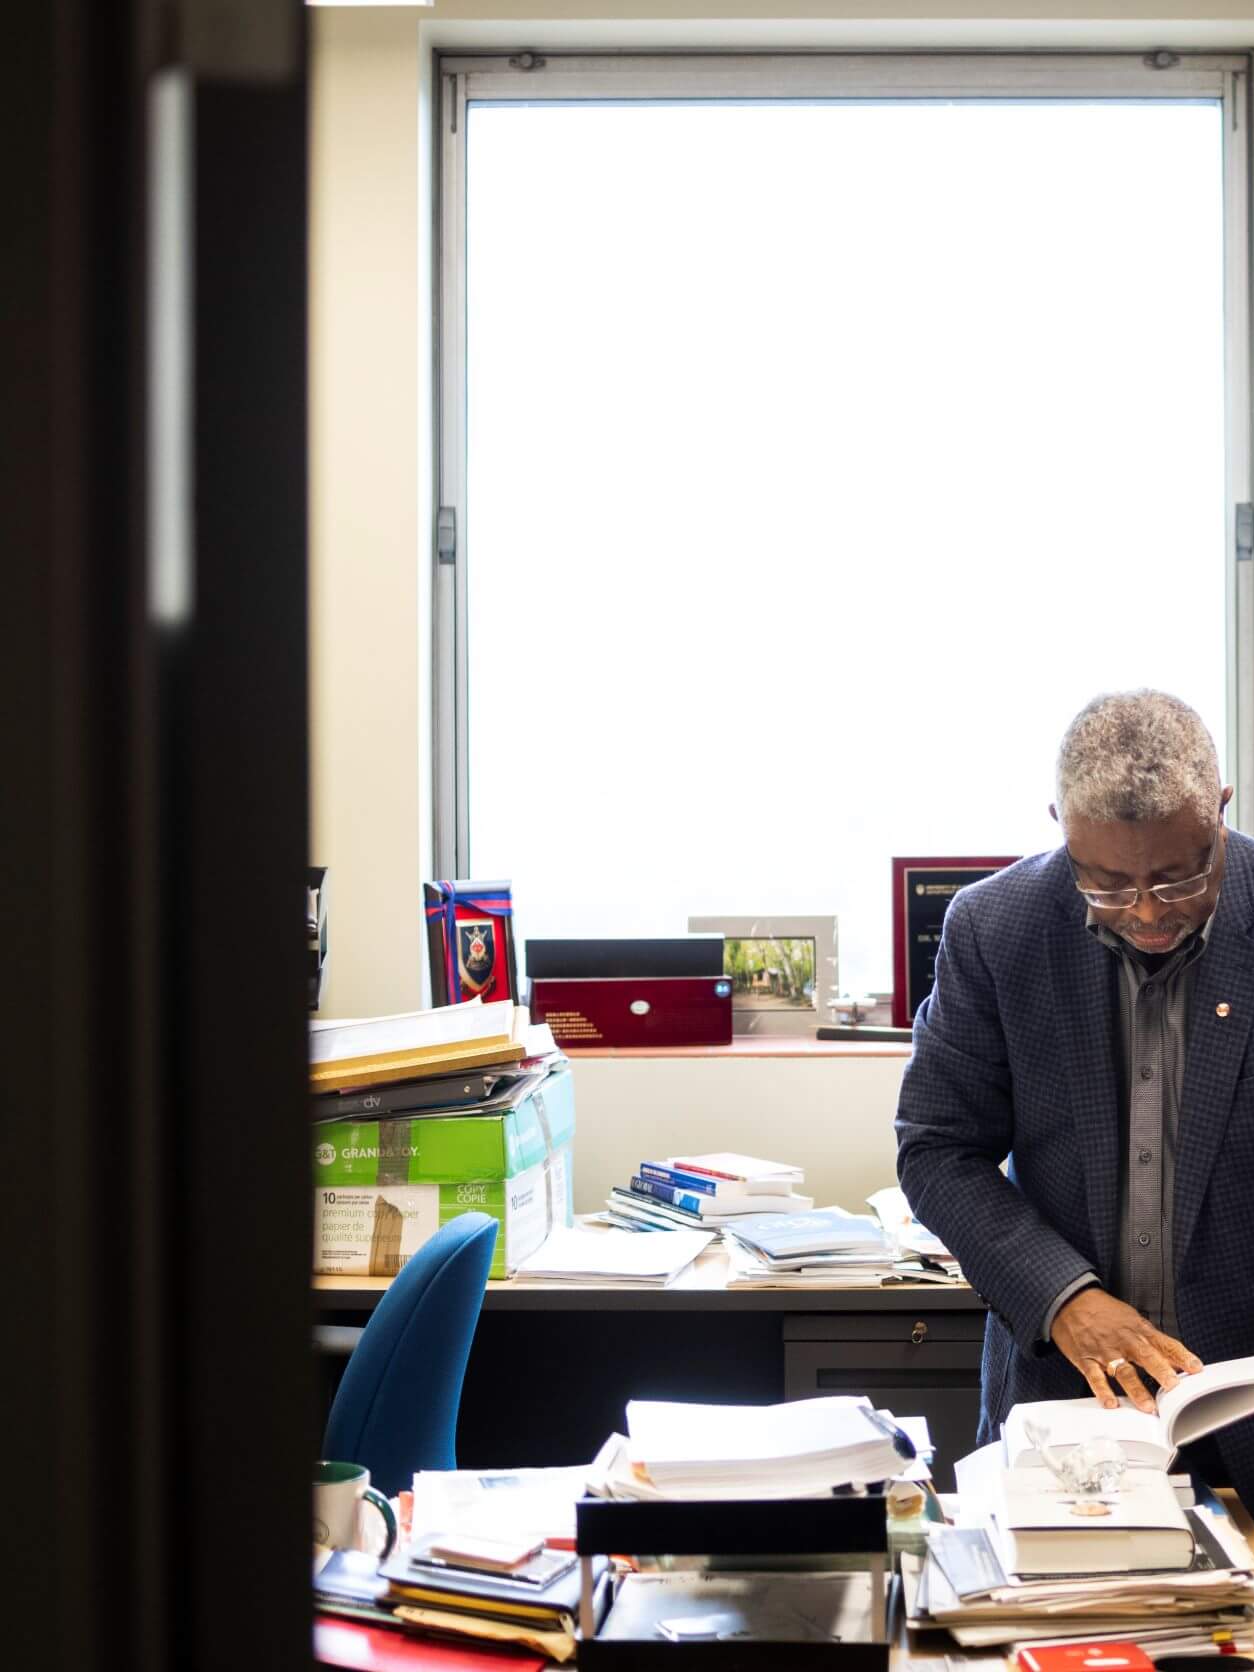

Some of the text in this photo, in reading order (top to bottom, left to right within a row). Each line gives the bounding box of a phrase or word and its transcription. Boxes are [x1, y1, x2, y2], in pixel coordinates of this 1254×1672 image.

[322, 1192, 336, 1205] 10
[457, 1194, 486, 1204] COPIE
[322, 1209, 365, 1218] premium
[322, 1221, 364, 1232] papier de
[322, 1232, 353, 1243] qualité
